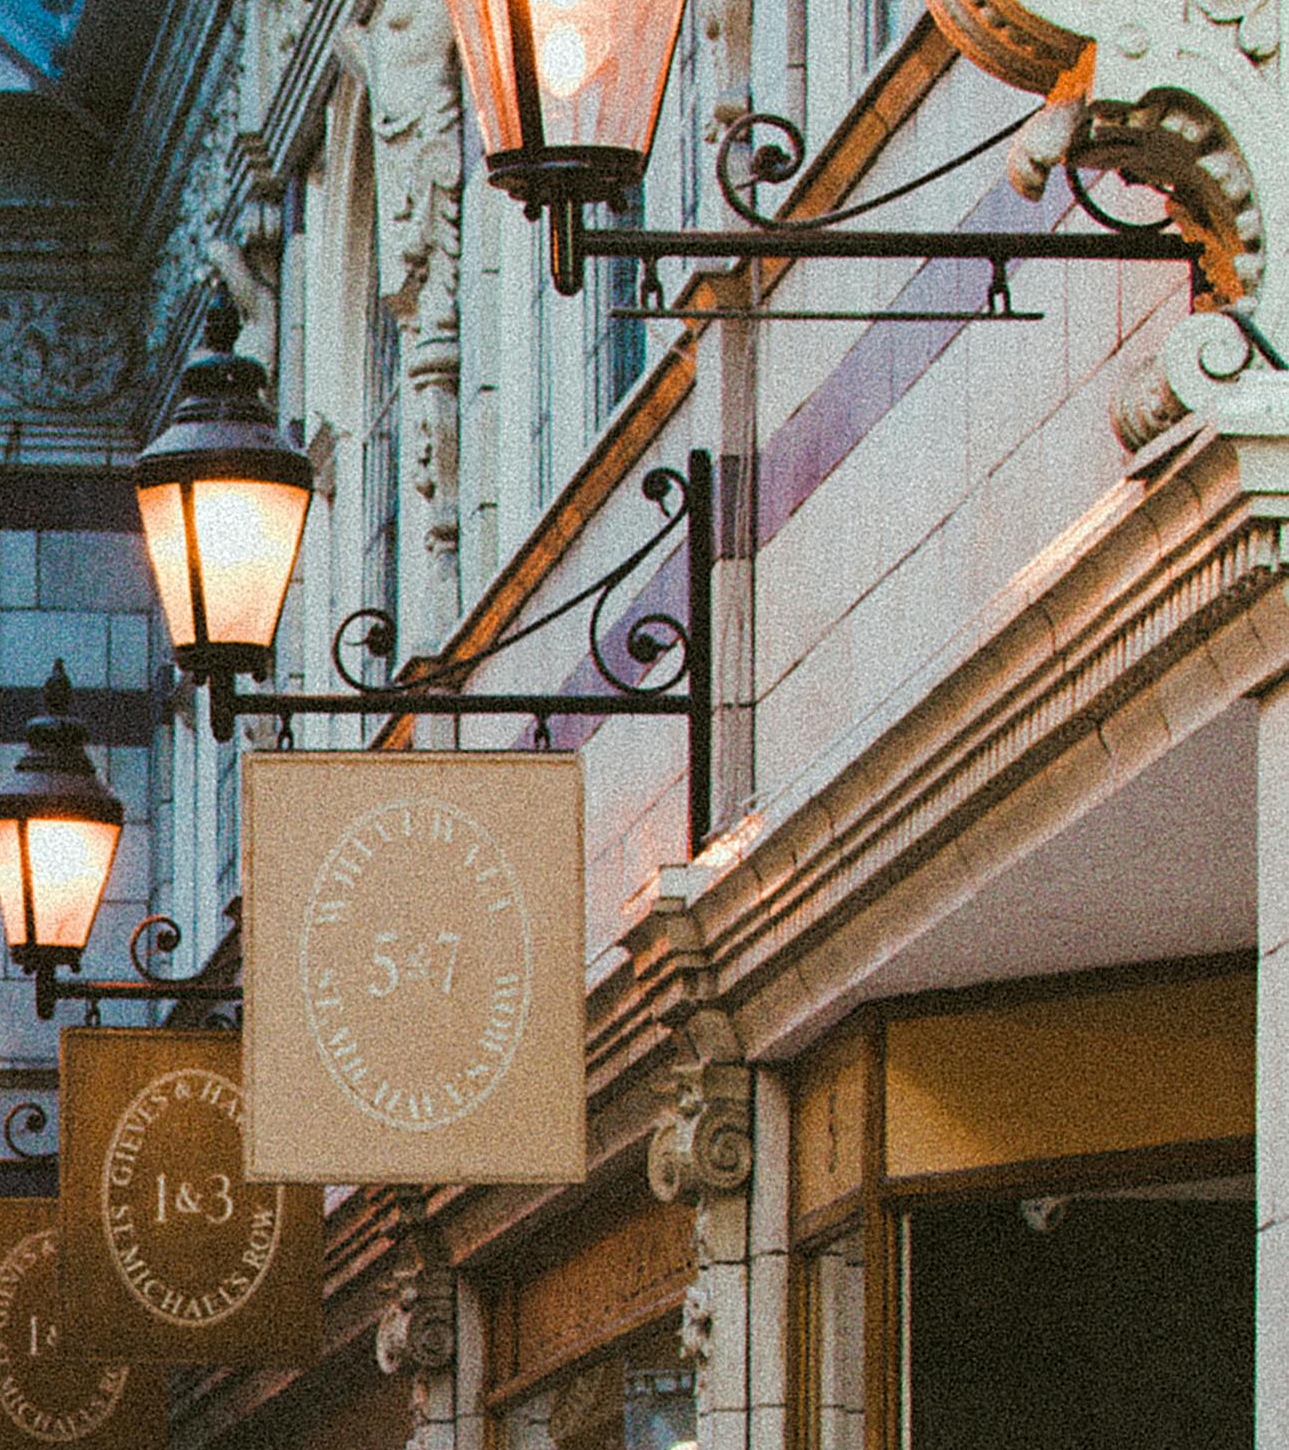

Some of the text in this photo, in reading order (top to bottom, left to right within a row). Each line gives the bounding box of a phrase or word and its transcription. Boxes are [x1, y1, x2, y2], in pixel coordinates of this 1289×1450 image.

[110, 1093, 169, 1187] GIEVES
[174, 1081, 192, 1101] &
[242, 1203, 274, 1270] ROW
